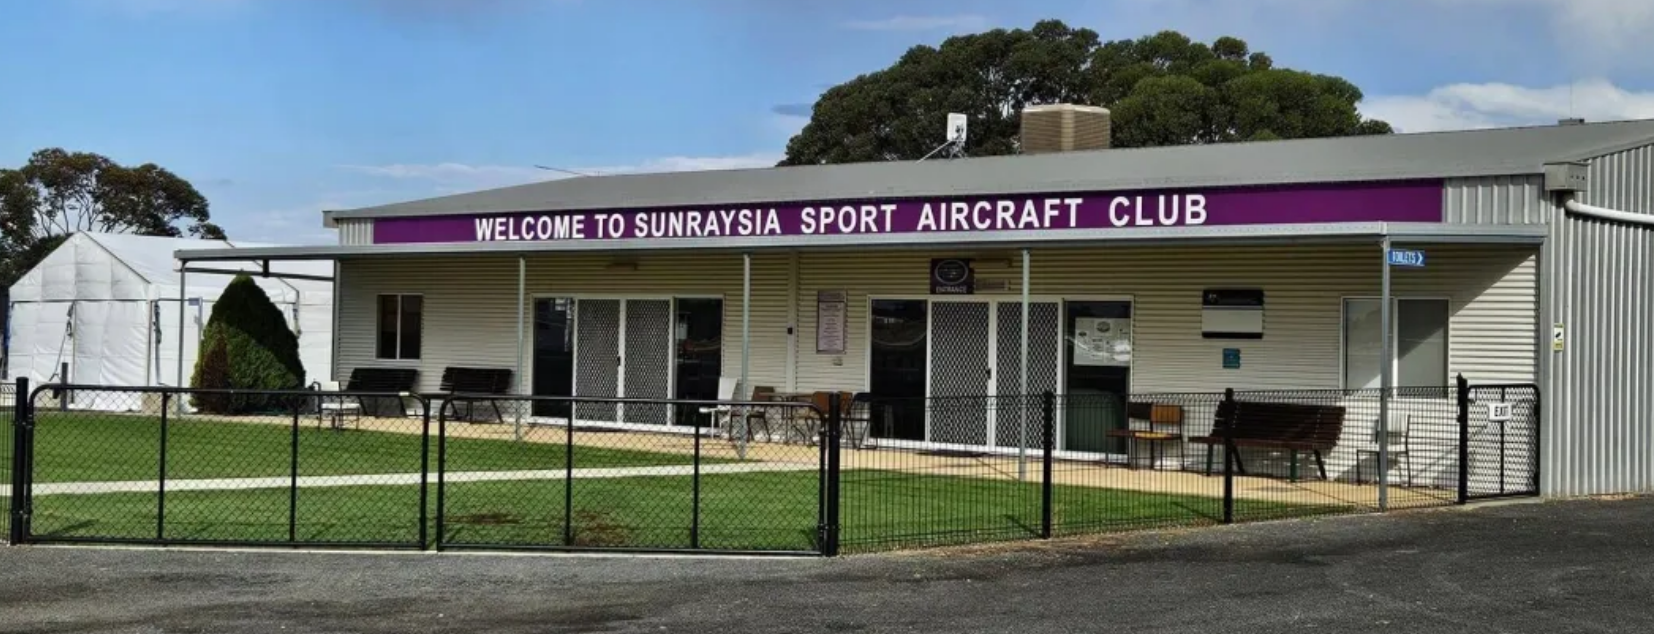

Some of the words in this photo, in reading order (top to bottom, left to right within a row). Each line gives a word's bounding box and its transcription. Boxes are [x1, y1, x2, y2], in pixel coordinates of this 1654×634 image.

[475, 213, 586, 242] WELCOME
[594, 213, 625, 239] TO
[634, 208, 782, 238] SUNRAYSIA
[800, 204, 897, 234] SPORT
[916, 197, 1083, 231] AIRCRAFT
[1108, 193, 1208, 228] CLUB
[1495, 405, 1509, 416] EXIT
